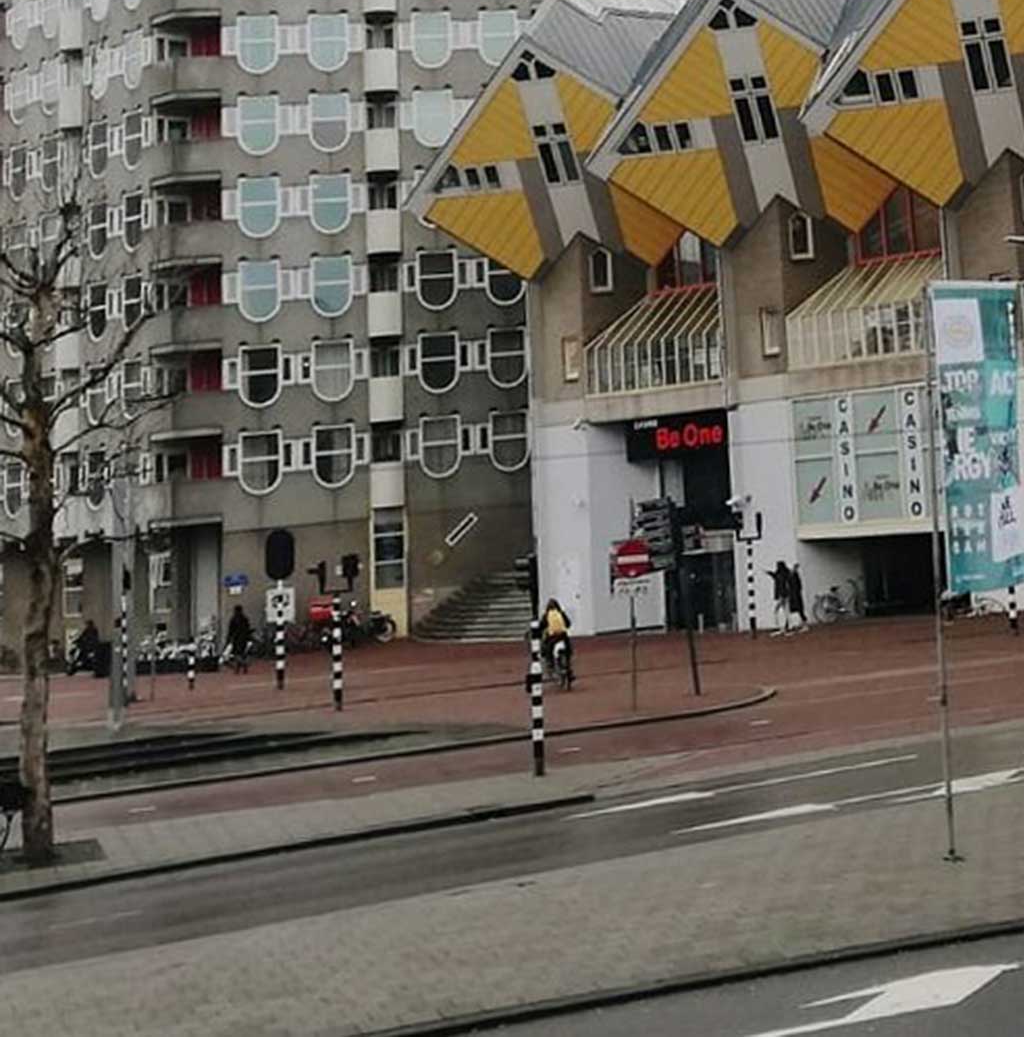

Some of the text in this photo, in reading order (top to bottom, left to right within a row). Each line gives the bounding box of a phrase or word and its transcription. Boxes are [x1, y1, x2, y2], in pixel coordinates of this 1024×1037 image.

[656, 427, 680, 450] Be
[683, 423, 723, 447] One
[837, 398, 856, 521] CASINO
[902, 391, 923, 517] CASINO
